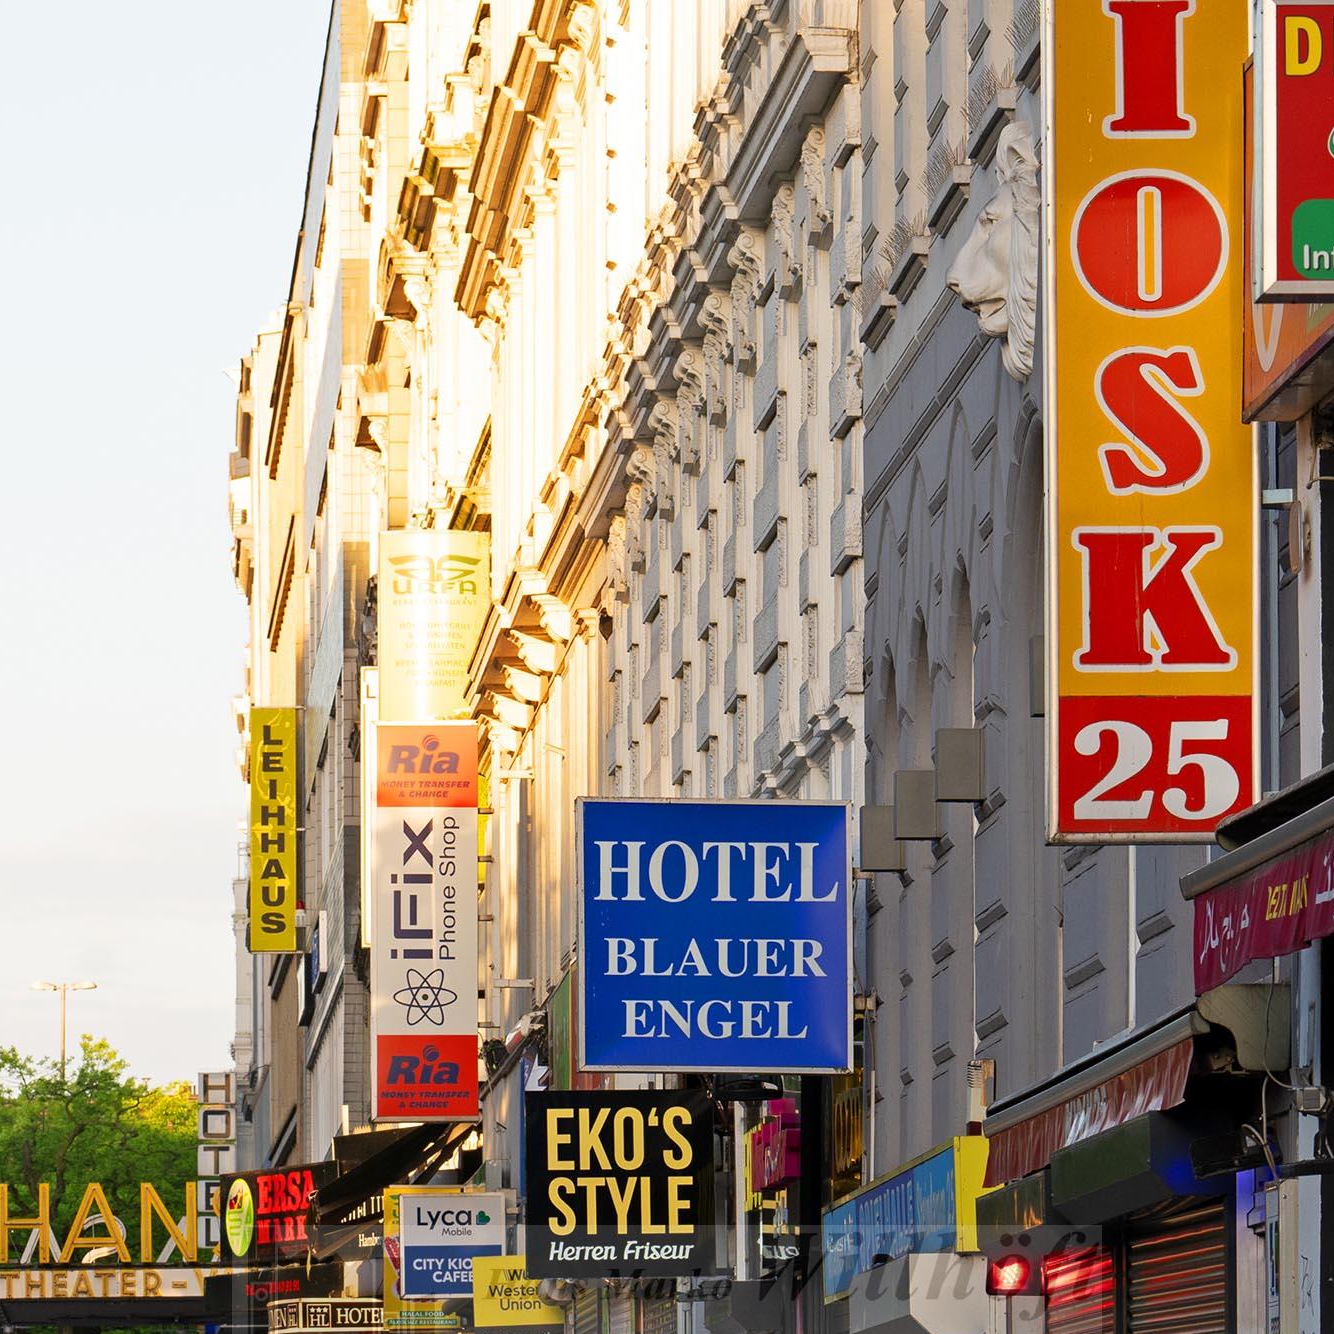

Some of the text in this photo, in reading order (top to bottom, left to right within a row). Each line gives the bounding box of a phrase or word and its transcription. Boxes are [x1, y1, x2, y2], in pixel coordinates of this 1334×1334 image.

[387, 734, 461, 775] Ria
[1072, 719, 1241, 820] 25
[381, 780, 470, 788] MONEY TRANSFER
[409, 790, 449, 798] CHANGE
[259, 724, 287, 935] LEIHHAUS
[439, 816, 460, 960] Phone Shop
[593, 841, 839, 903] HOTEL
[603, 937, 827, 978] BLAUER
[620, 999, 809, 1039] ENGEL
[387, 1045, 460, 1085] Ria
[546, 1107, 693, 1171] EKO'S
[416, 1206, 472, 1230] Lyca
[547, 1175, 695, 1236] STYLE
[441, 1227, 472, 1237] Mobile
[548, 1240, 695, 1262] Herren Friseur
[412, 1258, 444, 1271] CITY
[489, 1284, 540, 1298] Wester
[499, 1297, 542, 1312] Union
